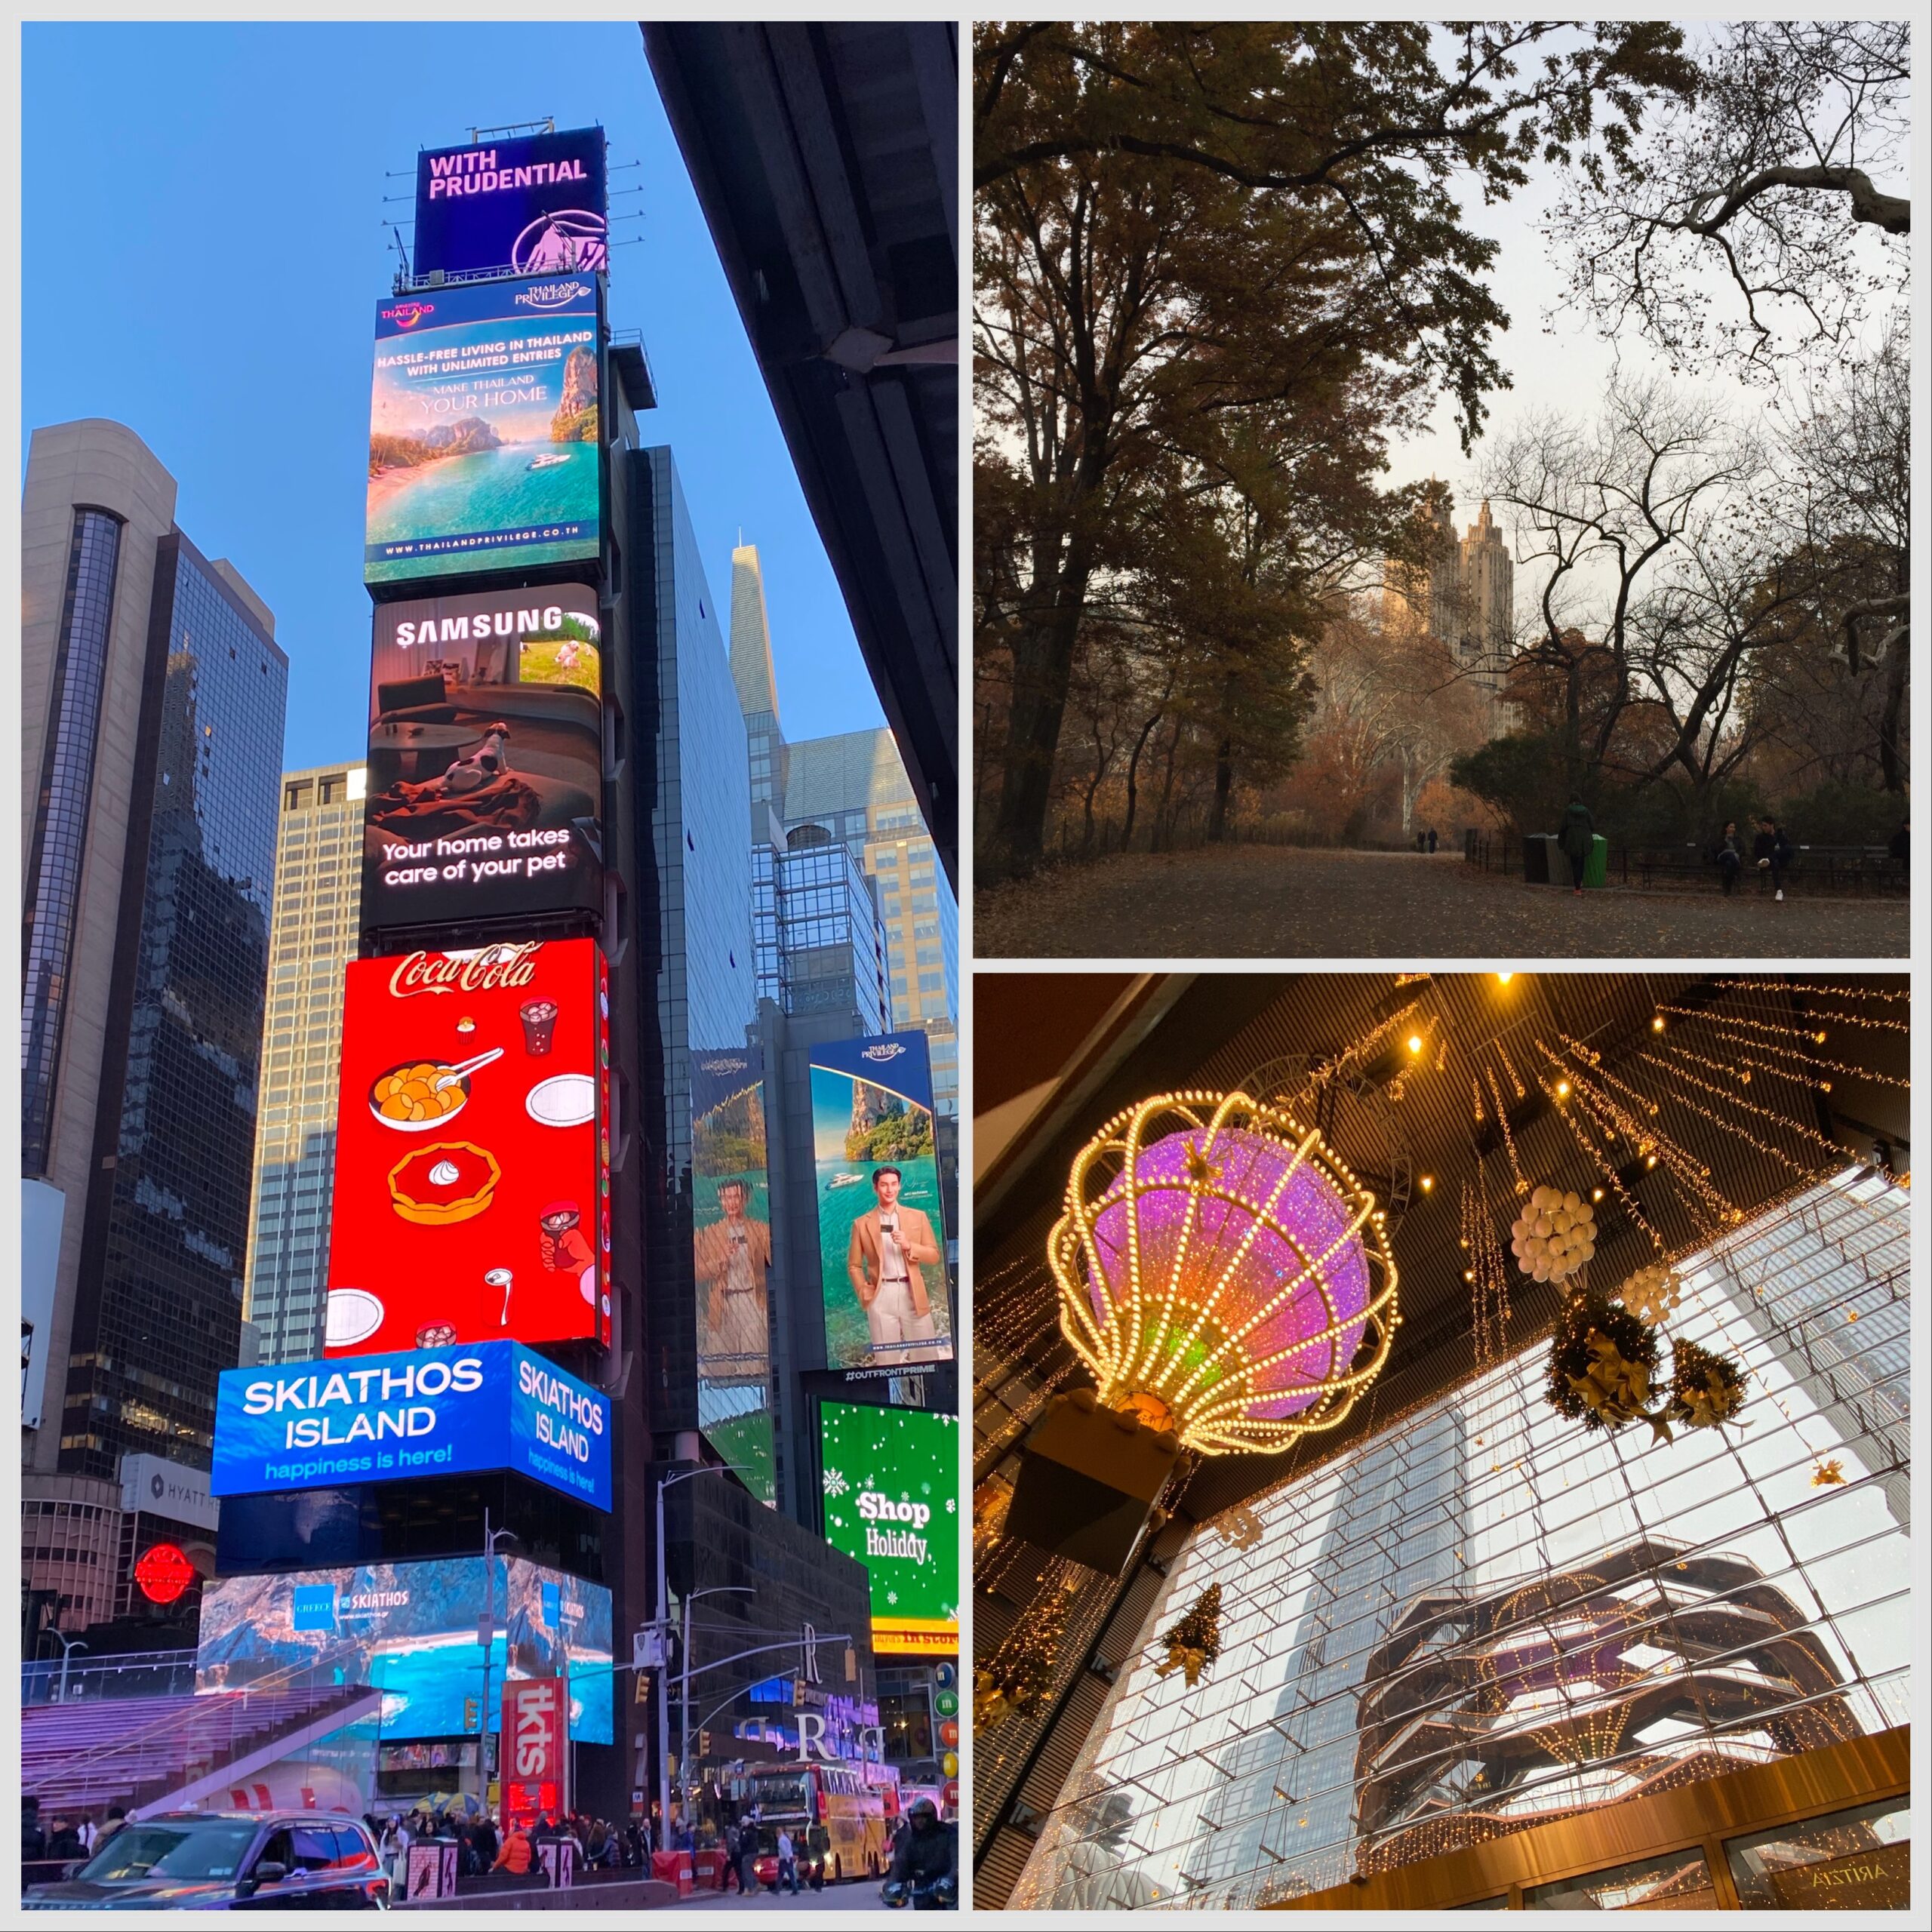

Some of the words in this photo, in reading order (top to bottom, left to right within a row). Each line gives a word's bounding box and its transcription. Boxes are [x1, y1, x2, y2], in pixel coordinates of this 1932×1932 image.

[429, 149, 496, 177] WITH
[429, 159, 587, 199] PRUDENTIAL
[515, 290, 574, 305] PRIVILEGE
[528, 281, 580, 294] THAILAND
[381, 305, 435, 318] THAILAND
[377, 348, 458, 368] HASSLE-FREE
[461, 343, 506, 357] LIVING
[509, 340, 523, 350] IN
[528, 331, 592, 348] THAILAND
[408, 364, 438, 377] WITH
[441, 355, 509, 372] UNLIMITED
[513, 348, 561, 363] ENTRIES
[422, 394, 478, 415] YOUR
[485, 386, 547, 408] HOME
[433, 383, 468, 395] MAKE
[473, 374, 534, 389] THAILAND
[386, 527, 579, 555] WWW.THAILANDPRIVILEGE.CO.TH
[396, 606, 563, 647] SAMSUNG
[383, 841, 432, 862] Your
[437, 834, 503, 857] home
[506, 828, 570, 849] takes
[385, 865, 438, 886] care
[442, 860, 466, 880] of
[471, 857, 522, 883] your
[527, 851, 566, 877] pet
[242, 1358, 484, 1416] SKIATHOS
[845, 1364, 935, 1381] #OUTFRONTPRIME
[519, 1361, 603, 1435] SKIATHOS
[285, 1407, 436, 1449] ISLAND
[537, 1411, 589, 1463] ISLAND
[265, 1450, 371, 1481] happiness
[377, 1452, 393, 1469] is
[398, 1444, 453, 1467] here!
[528, 1447, 568, 1481] happiness
[569, 1467, 576, 1484] is
[577, 1472, 595, 1494] here!
[168, 1483, 205, 1506] HYATT
[860, 1491, 930, 1528] Shop
[296, 1603, 331, 1614] GREECE
[352, 1590, 408, 1609] SKIATHOS
[516, 1684, 555, 1777] tkts
[794, 1713, 840, 1762] R
